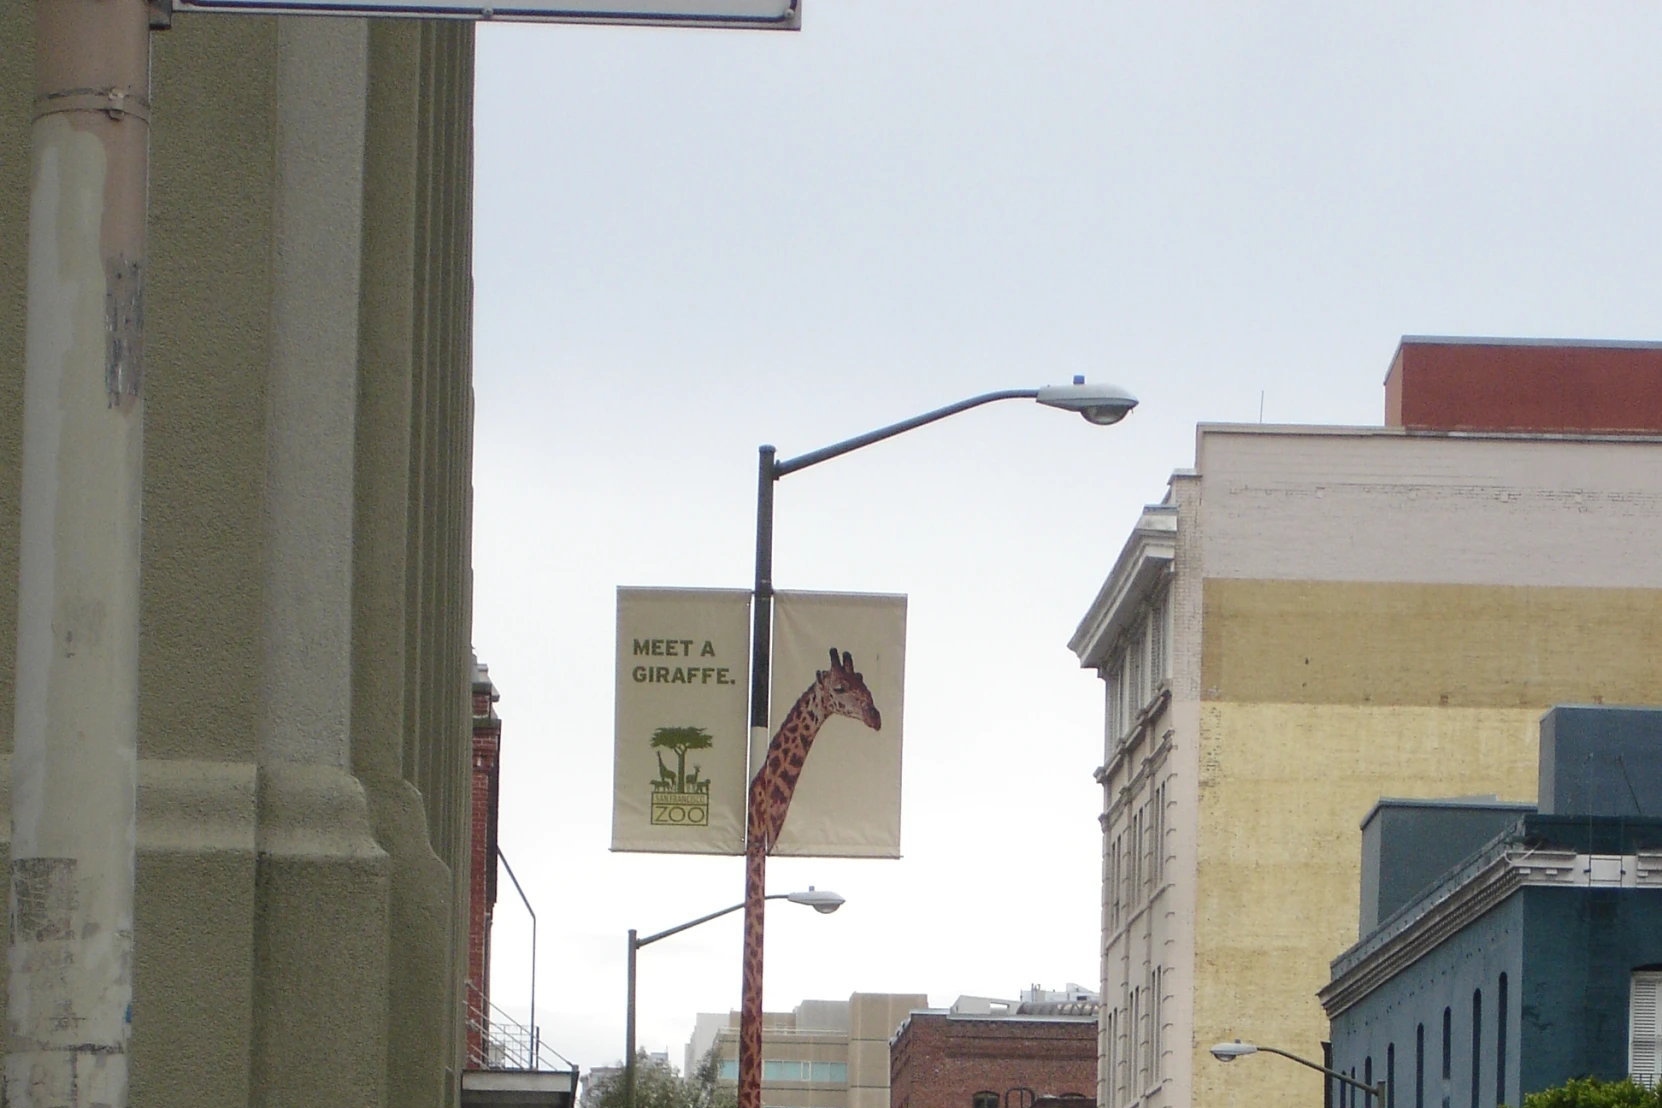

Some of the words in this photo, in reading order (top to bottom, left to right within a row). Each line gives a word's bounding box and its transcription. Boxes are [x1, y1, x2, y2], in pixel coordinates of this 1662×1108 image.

[632, 638, 694, 657] MEET
[700, 640, 716, 658] A
[631, 666, 736, 685] GIRAFFE.
[654, 805, 706, 824] ZOO
